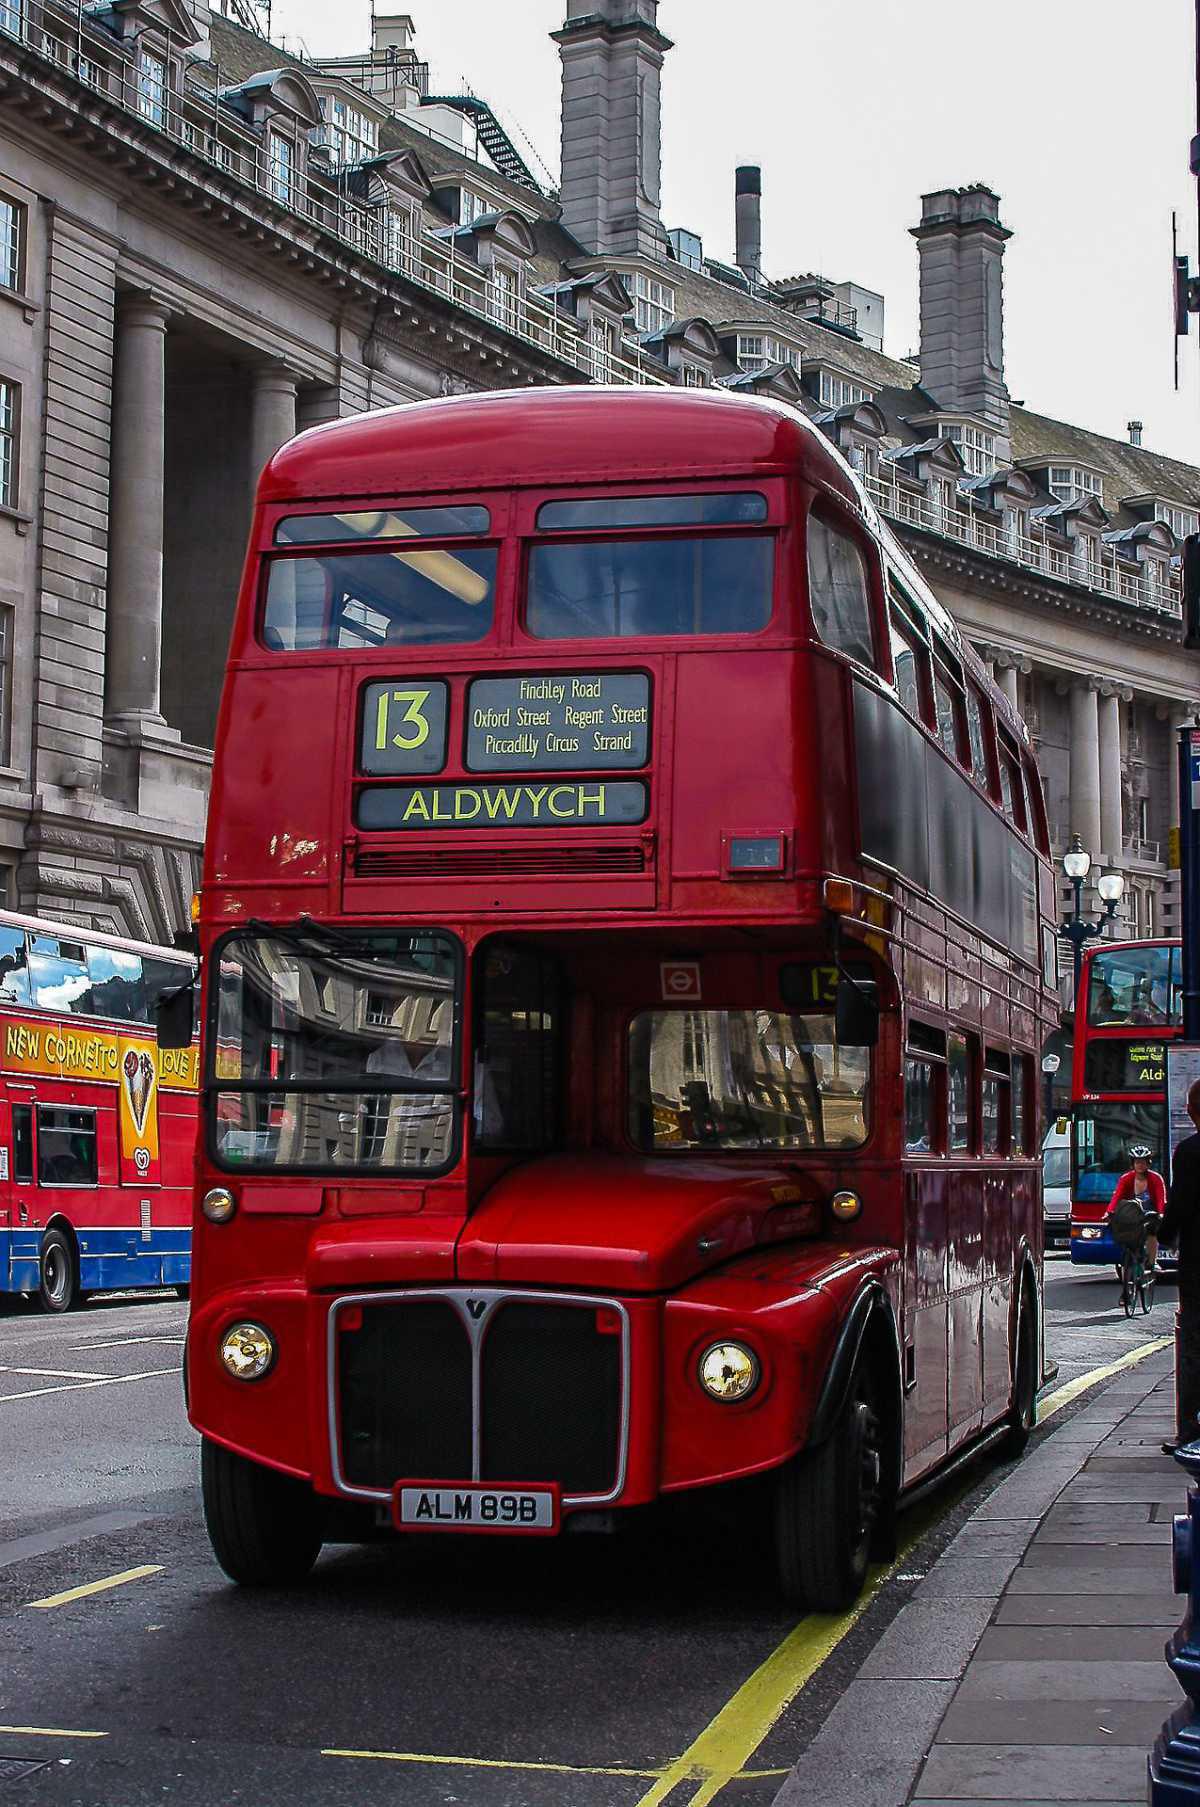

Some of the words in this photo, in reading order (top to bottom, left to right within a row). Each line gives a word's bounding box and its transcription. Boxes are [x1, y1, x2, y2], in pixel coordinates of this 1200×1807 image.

[520, 680, 565, 704] Finchley
[571, 678, 601, 698] Road
[375, 690, 431, 750] 13
[473, 708, 510, 728] Oxford
[516, 707, 551, 727] Street
[565, 705, 604, 729] Regent
[611, 703, 648, 724] Street
[485, 733, 539, 759] Piccadilly
[546, 732, 579, 752] Circus
[593, 731, 632, 751] Strand
[402, 785, 606, 822] ALDWYCH
[6, 1025, 40, 1060] NEW
[45, 1032, 118, 1074] CORNETTO
[415, 1493, 472, 1520] ALM
[479, 1494, 537, 1522] 89B
